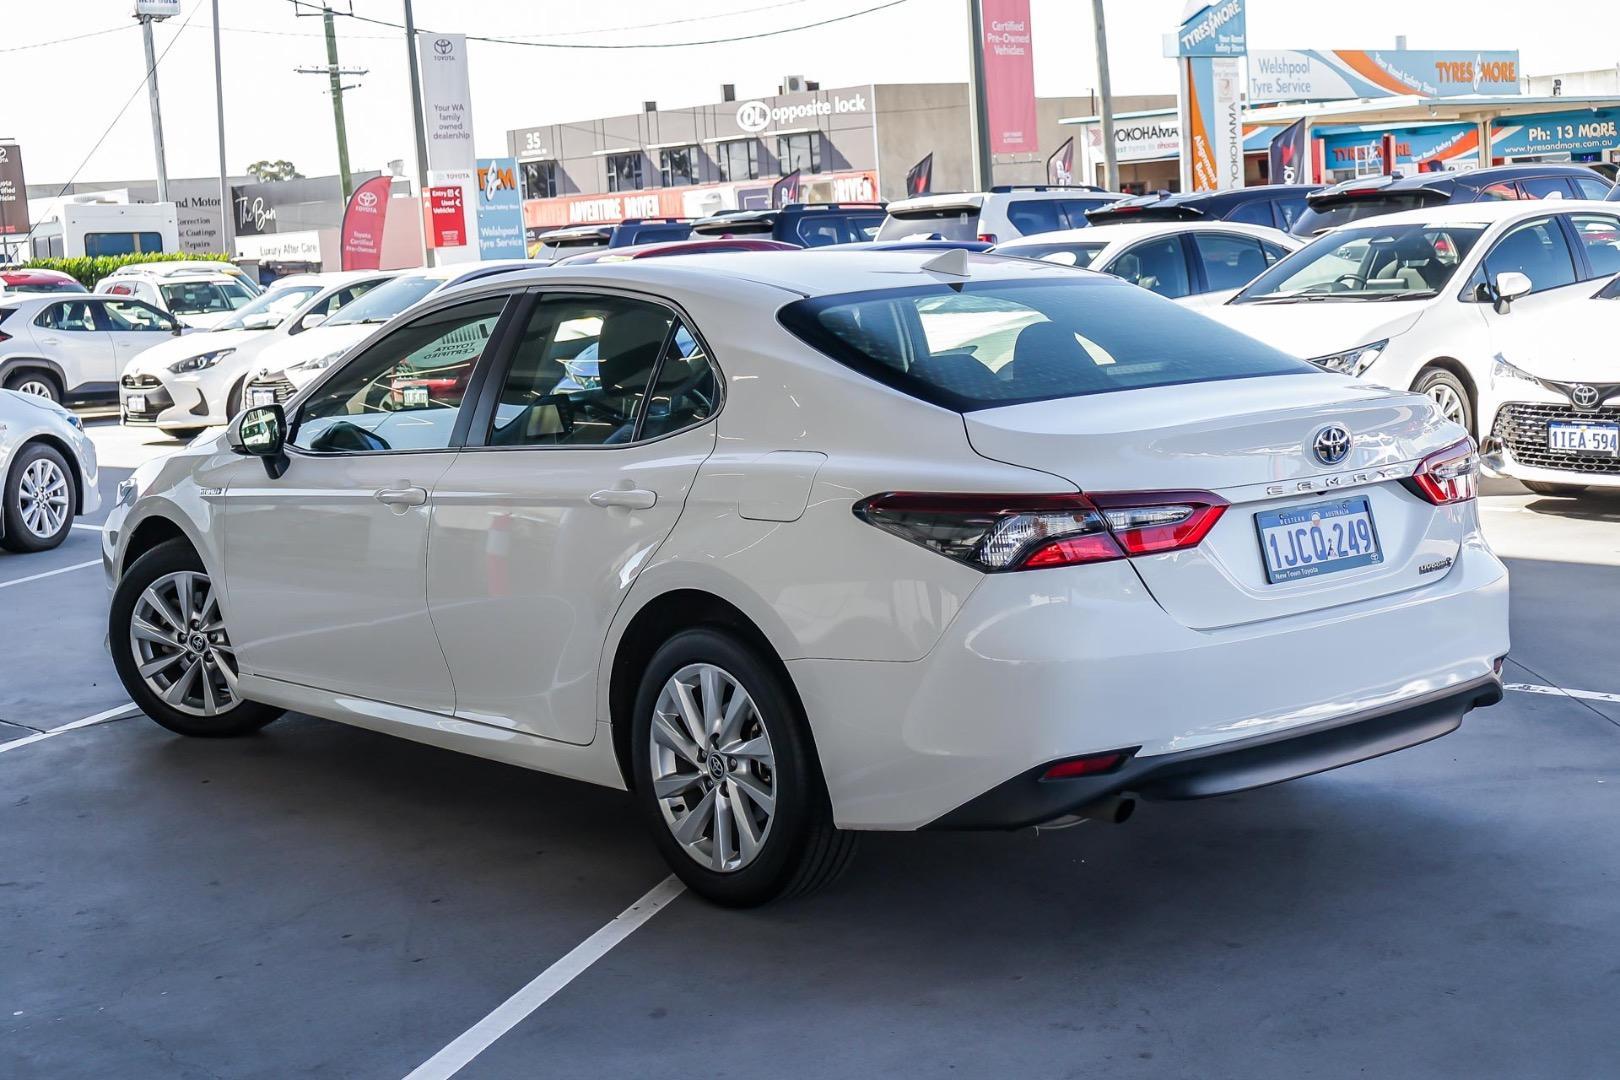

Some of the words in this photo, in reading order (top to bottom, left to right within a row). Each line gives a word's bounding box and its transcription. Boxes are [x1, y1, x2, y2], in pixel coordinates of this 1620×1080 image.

[992, 21, 1025, 31] Certified
[987, 33, 1030, 43] Pre-Owned
[994, 44, 1025, 55] Vehicles
[1258, 57, 1310, 77] Welshpool
[1252, 79, 1273, 96] Tyre
[1276, 79, 1311, 93] Service
[772, 99, 831, 124] opposite
[834, 94, 866, 113] lock
[440, 113, 460, 121] family
[439, 122, 462, 130] owned
[1529, 127, 1551, 141] Ph:
[1557, 126, 1574, 139] 13
[1578, 122, 1615, 138] MORE
[433, 132, 470, 140] dealership
[526, 132, 541, 149] 35
[1229, 102, 1239, 188] YOKOHAMA
[432, 190, 447, 198] Entry
[481, 226, 518, 238] Welshpool
[302, 243, 317, 253] Care
[496, 239, 523, 248] Service
[1333, 519, 1372, 558] 249
[1276, 572, 1287, 580] New
[1287, 570, 1301, 578] Town
[1301, 567, 1319, 576] Toyota
